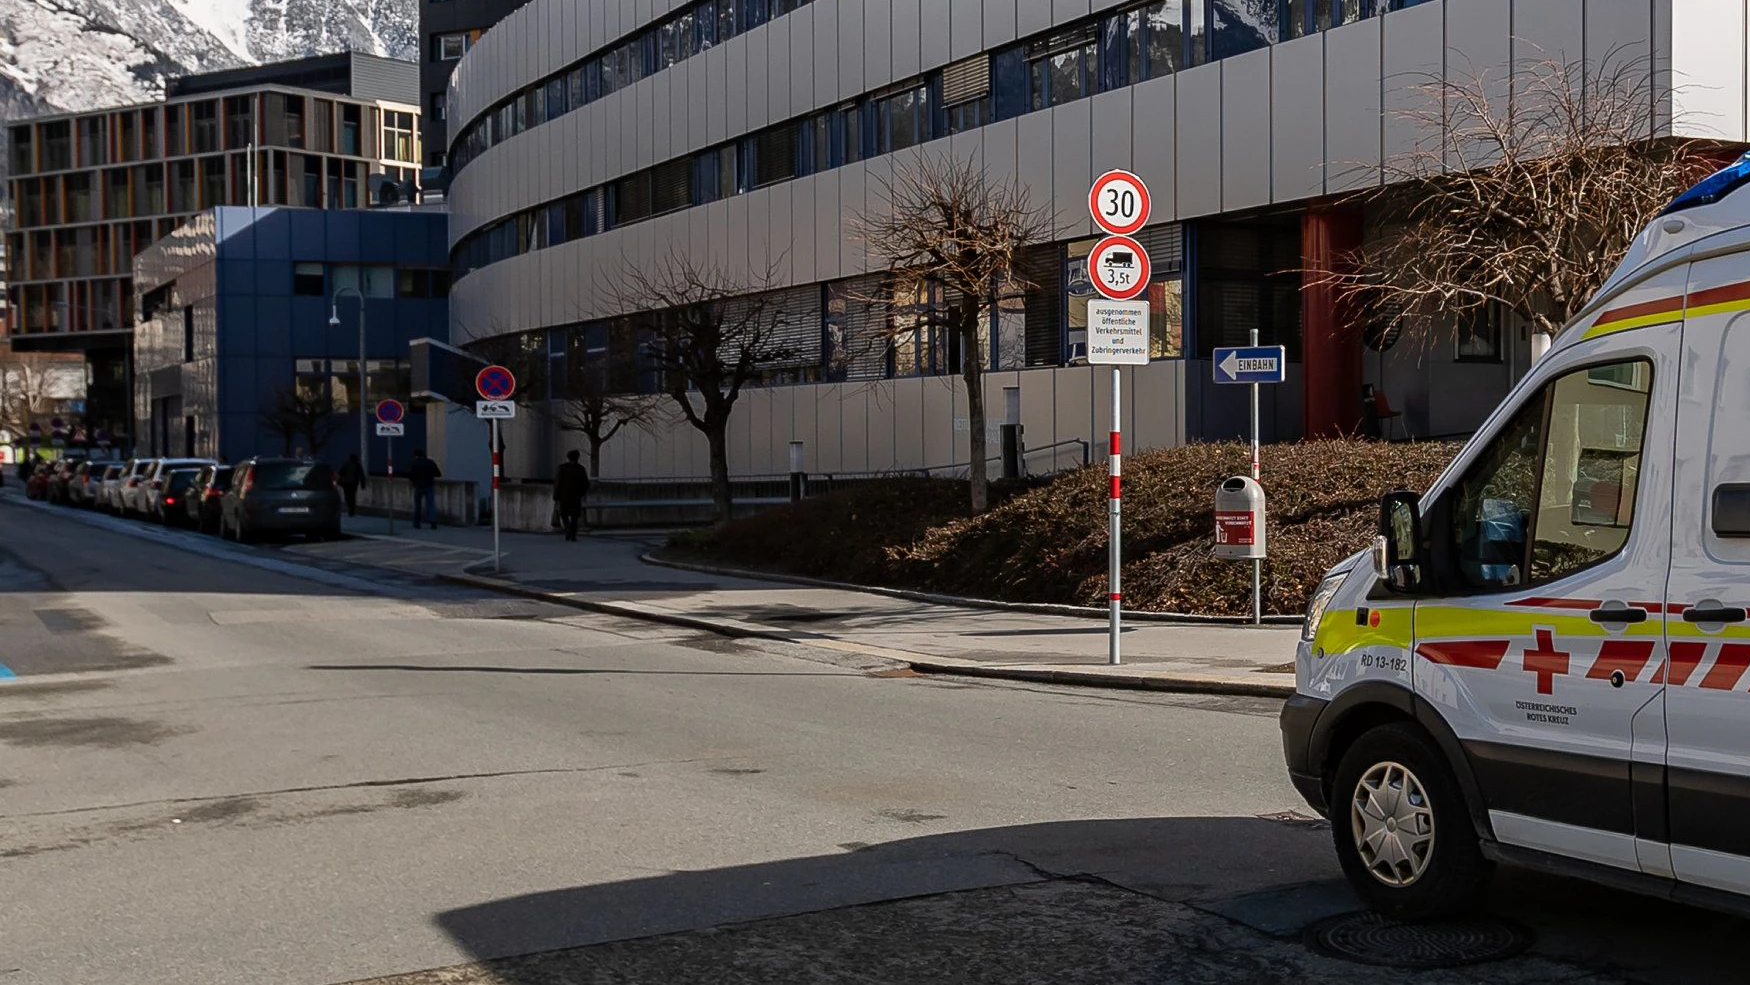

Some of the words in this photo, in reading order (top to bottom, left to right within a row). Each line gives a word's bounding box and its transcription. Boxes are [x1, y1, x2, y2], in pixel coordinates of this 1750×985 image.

[1105, 188, 1134, 218] 30
[1107, 268, 1130, 286] 3,5t
[1102, 317, 1136, 326] öffentliche
[1095, 327, 1143, 335] Verkehrsmittel
[1091, 346, 1146, 356] Zubringerverkehr
[1238, 359, 1274, 371] EINBAHN
[1361, 654, 1373, 667] RD
[1375, 656, 1407, 672] 13-182
[1526, 712, 1547, 723] ROTES
[1548, 715, 1569, 726] KREUZ
